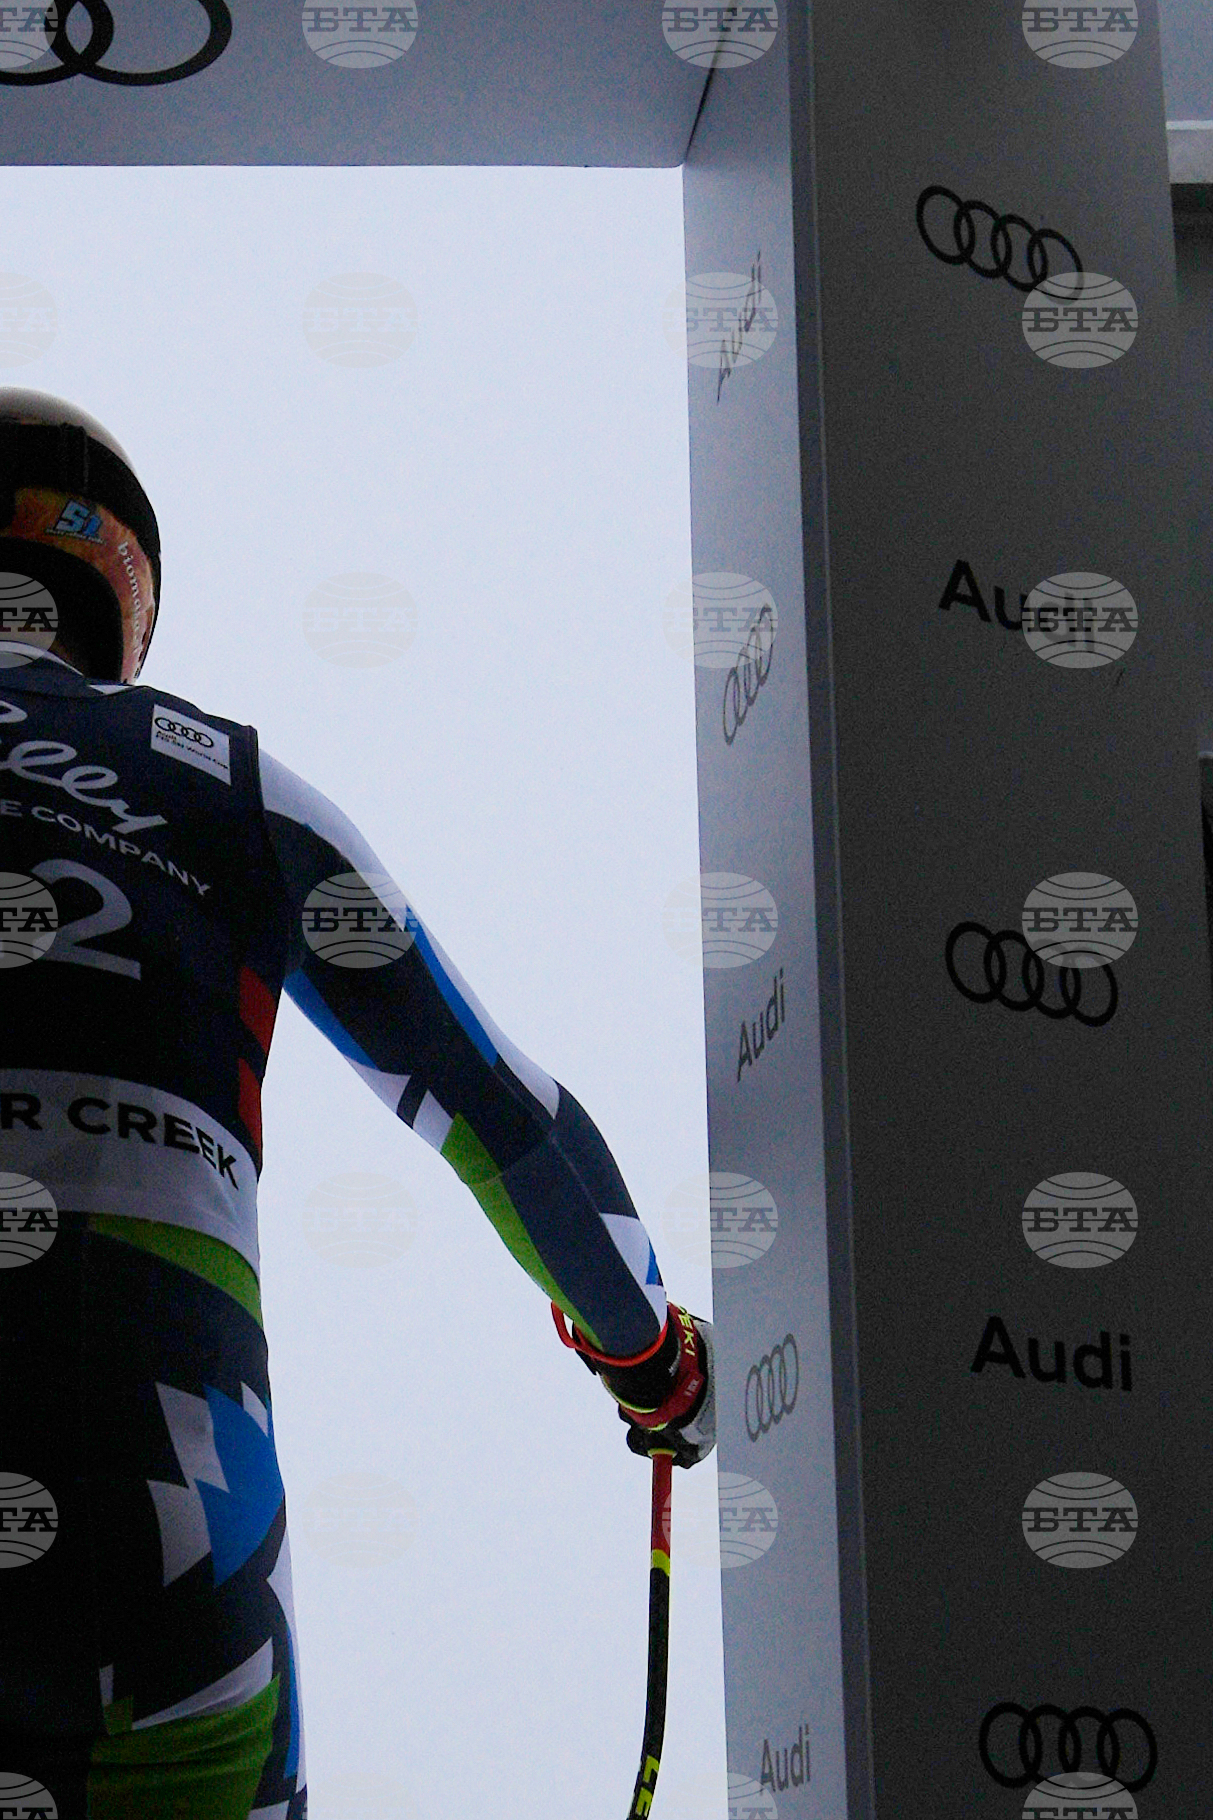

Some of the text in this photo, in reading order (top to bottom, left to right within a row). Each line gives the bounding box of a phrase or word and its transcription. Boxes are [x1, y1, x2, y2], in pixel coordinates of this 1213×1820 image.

[31, 806, 211, 896] COMPANY
[737, 967, 785, 1083] Audi
[68, 1097, 238, 1190] CREEK
[970, 1316, 1132, 1391] Audi
[760, 1723, 811, 1797] Audi
